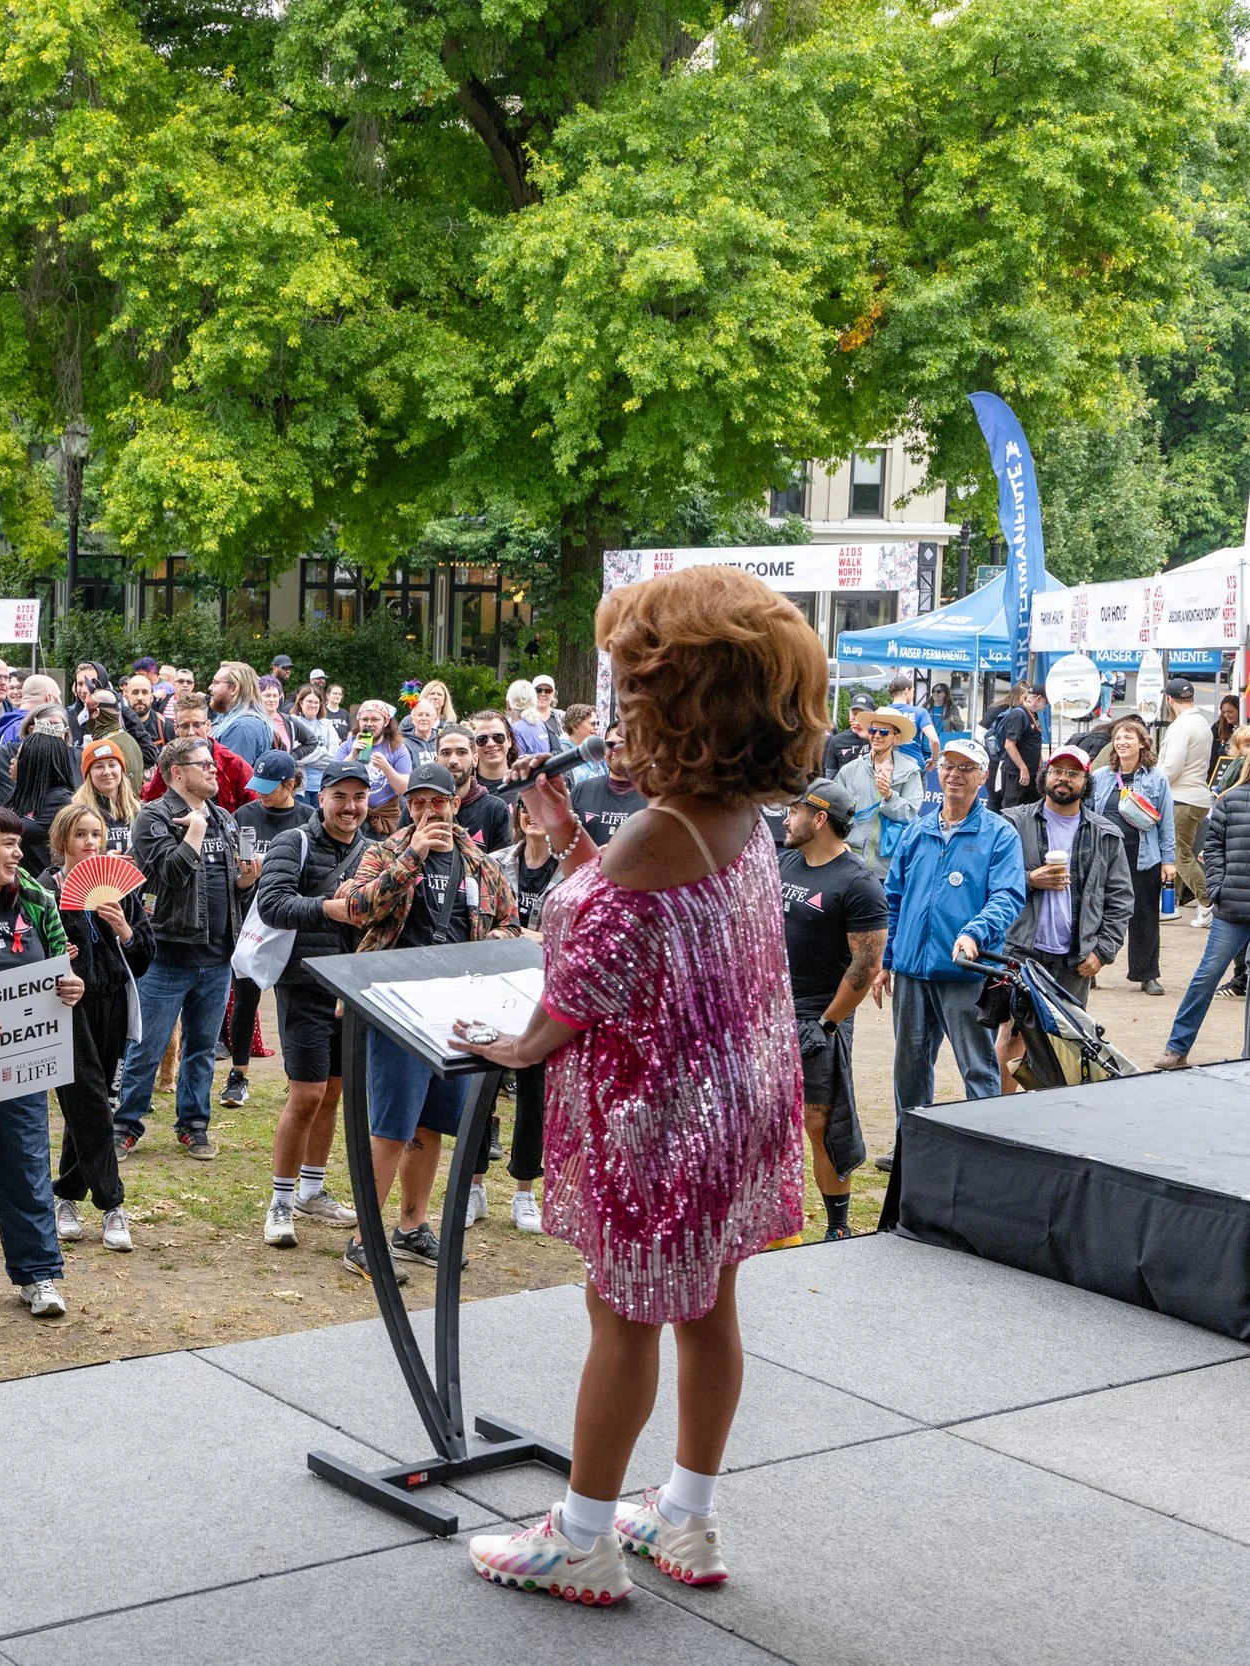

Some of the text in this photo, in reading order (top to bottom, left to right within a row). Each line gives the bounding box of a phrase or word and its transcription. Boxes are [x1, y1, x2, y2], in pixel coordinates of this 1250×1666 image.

[654, 552, 674, 560] AIDS
[839, 547, 862, 556] AIDS
[654, 562, 673, 570] WALK
[839, 558, 862, 566] WALK
[838, 568, 862, 576] NORTH
[838, 578, 862, 587] WEST
[14, 630, 33, 638] WEST
[843, 643, 863, 657] kp.org
[900, 647, 920, 658] KAISER
[1096, 651, 1132, 661] KAISER
[203, 841, 224, 852] IFE
[428, 878, 448, 890] LIF
[0, 1020, 58, 1046] DEATH
[28, 1058, 48, 1066] WALKS
[16, 1061, 57, 1084] LIFE
